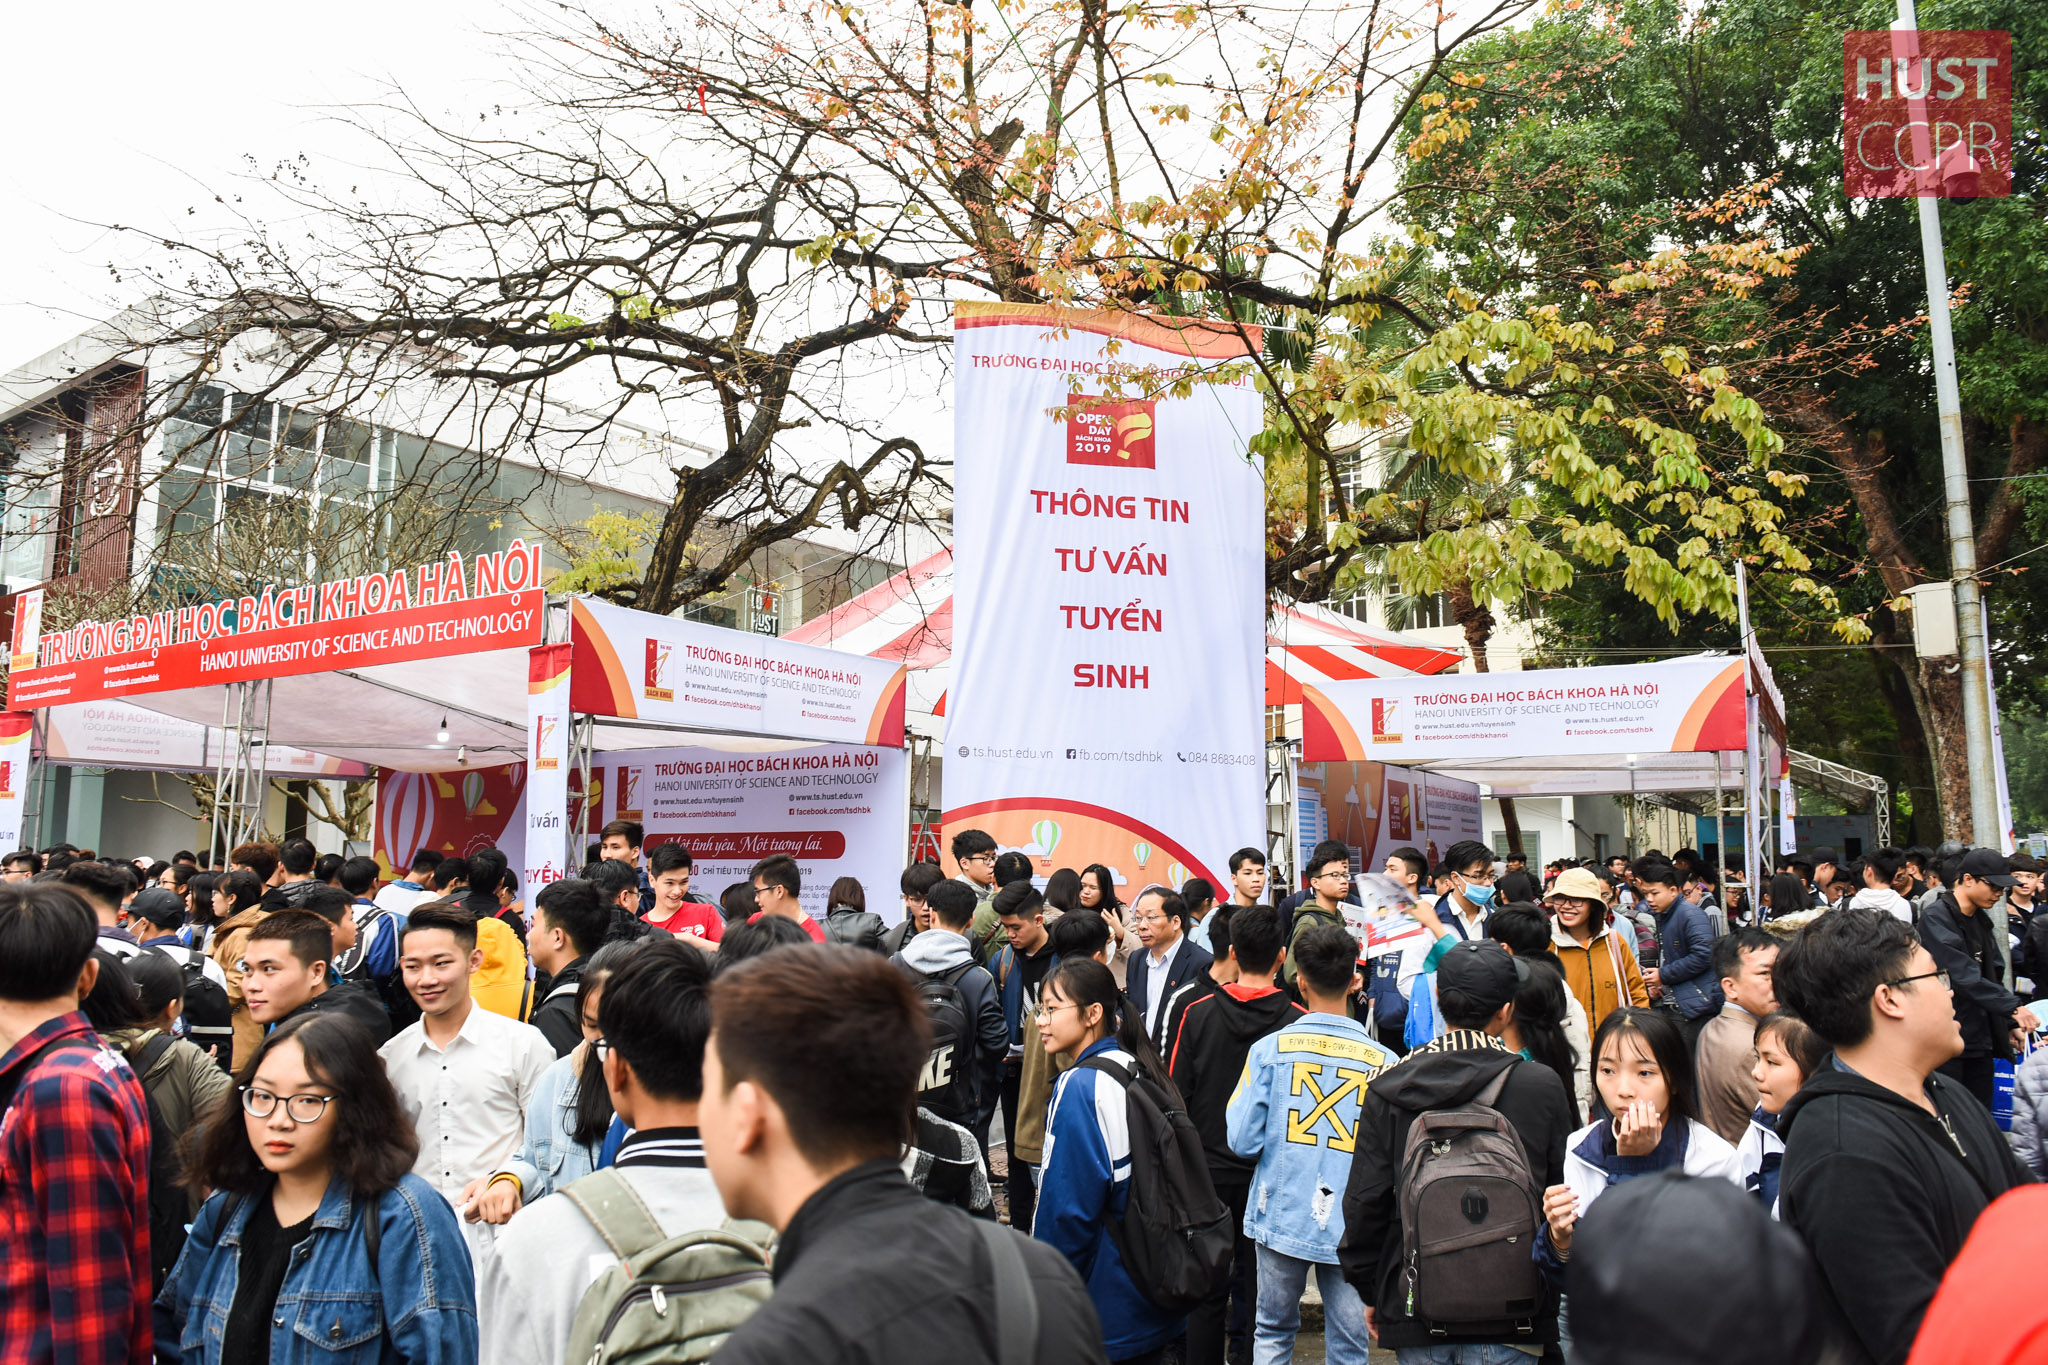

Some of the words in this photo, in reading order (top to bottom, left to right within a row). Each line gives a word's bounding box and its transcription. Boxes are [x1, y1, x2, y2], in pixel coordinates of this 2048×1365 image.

[972, 353, 1037, 369] TRƯỜNG
[1040, 359, 1067, 372] ĐẠI
[1072, 361, 1104, 376] HỌC
[1076, 412, 1112, 426] OPEN
[1075, 434, 1093, 442] BÁCH
[1088, 425, 1112, 436] DAY
[1075, 442, 1111, 454] 2019
[1030, 487, 1136, 519] THÔNG
[1143, 497, 1189, 524] TIN
[1054, 546, 1097, 573] TƯ
[1102, 542, 1168, 576] VẤN
[40, 619, 128, 667] TRƯỜNG
[131, 610, 173, 659] ĐẠI
[178, 599, 235, 651] HỌC
[237, 584, 316, 634] BÁCH
[320, 569, 410, 622] KHOA
[417, 550, 468, 606] HÀ
[474, 538, 542, 607] NỘI
[751, 611, 778, 634] HUST
[1059, 598, 1163, 632] TUYỂN
[200, 650, 238, 672] HANOI
[240, 640, 310, 667] UNIVERSITY
[311, 637, 330, 658] OF
[332, 629, 388, 655] SCIENCE
[391, 624, 424, 647] AND
[426, 609, 534, 642] TECHNOLOGY
[686, 645, 732, 666] TRƯỜNG
[733, 654, 753, 672] ĐẠI
[754, 659, 776, 675] HỌC
[778, 660, 803, 677] BÁCH
[804, 666, 830, 681] KHOA
[832, 667, 845, 682] HÀ
[846, 670, 862, 687] NỘI
[686, 664, 714, 678] HANOI
[714, 667, 759, 685] UNIVERSITY
[760, 675, 770, 685] OF
[771, 676, 800, 691] SCIENCE
[802, 682, 818, 693] AND
[818, 684, 862, 700] TECHNOLOGY
[1073, 663, 1149, 690] SINH
[691, 682, 768, 699] www.hust.edu.vn/tuyensinh
[1414, 692, 1468, 706] TRƯỜNG
[1470, 692, 1493, 707] ĐẠI
[1497, 690, 1525, 705] HỌC
[1528, 687, 1562, 701] BÁCH
[1567, 687, 1607, 699] KHOA
[1610, 684, 1629, 697] HÀ
[1633, 682, 1660, 699] NỘI
[1415, 708, 1446, 719] HANOI
[1448, 706, 1503, 718] UNIVERSITY
[1505, 706, 1518, 716] OF
[1521, 704, 1562, 715] SCIENCE
[1564, 703, 1587, 713] AND
[1589, 699, 1660, 712] TECHNOLOGY
[1422, 720, 1516, 731] www.hust.edu.vn/tuyensinh
[1572, 715, 1645, 724] www.ts.hust.edu.vn
[1422, 731, 1509, 741] facebook.com/dhbkhanoi
[1573, 726, 1654, 736] facebook.com/tsdhbk
[973, 746, 1054, 759] ts.hust.edu.vn
[1079, 748, 1163, 763] fb.com/tsdhbk
[1187, 752, 1208, 764] 084
[1210, 752, 1256, 766] 8683408
[655, 761, 703, 776] TRƯỜNG
[705, 761, 726, 777] ĐẠI
[728, 759, 755, 775] HỌC
[756, 756, 791, 772] BÁCH
[793, 755, 830, 770] KHOA
[832, 752, 850, 768] HÀ
[853, 751, 879, 768] NỘI
[655, 781, 683, 792] HANOI
[684, 778, 733, 791] UNIVERSITY
[735, 778, 747, 789] OF
[749, 776, 787, 788] SCIENCE
[788, 775, 810, 787] AND
[811, 772, 879, 787] TECHNOLOGY
[660, 796, 744, 806] www.hust.edu.vn/tuyensinh
[795, 792, 863, 801] www.ts.hust.edu.vn
[660, 809, 737, 819] facebook.com/dhbkhanoi
[796, 806, 872, 816] facebook.com/tsdhbk
[739, 835, 769, 854] Một
[770, 839, 803, 857] tương
[702, 864, 715, 875] CHỈ
[716, 865, 732, 875] TIÊU
